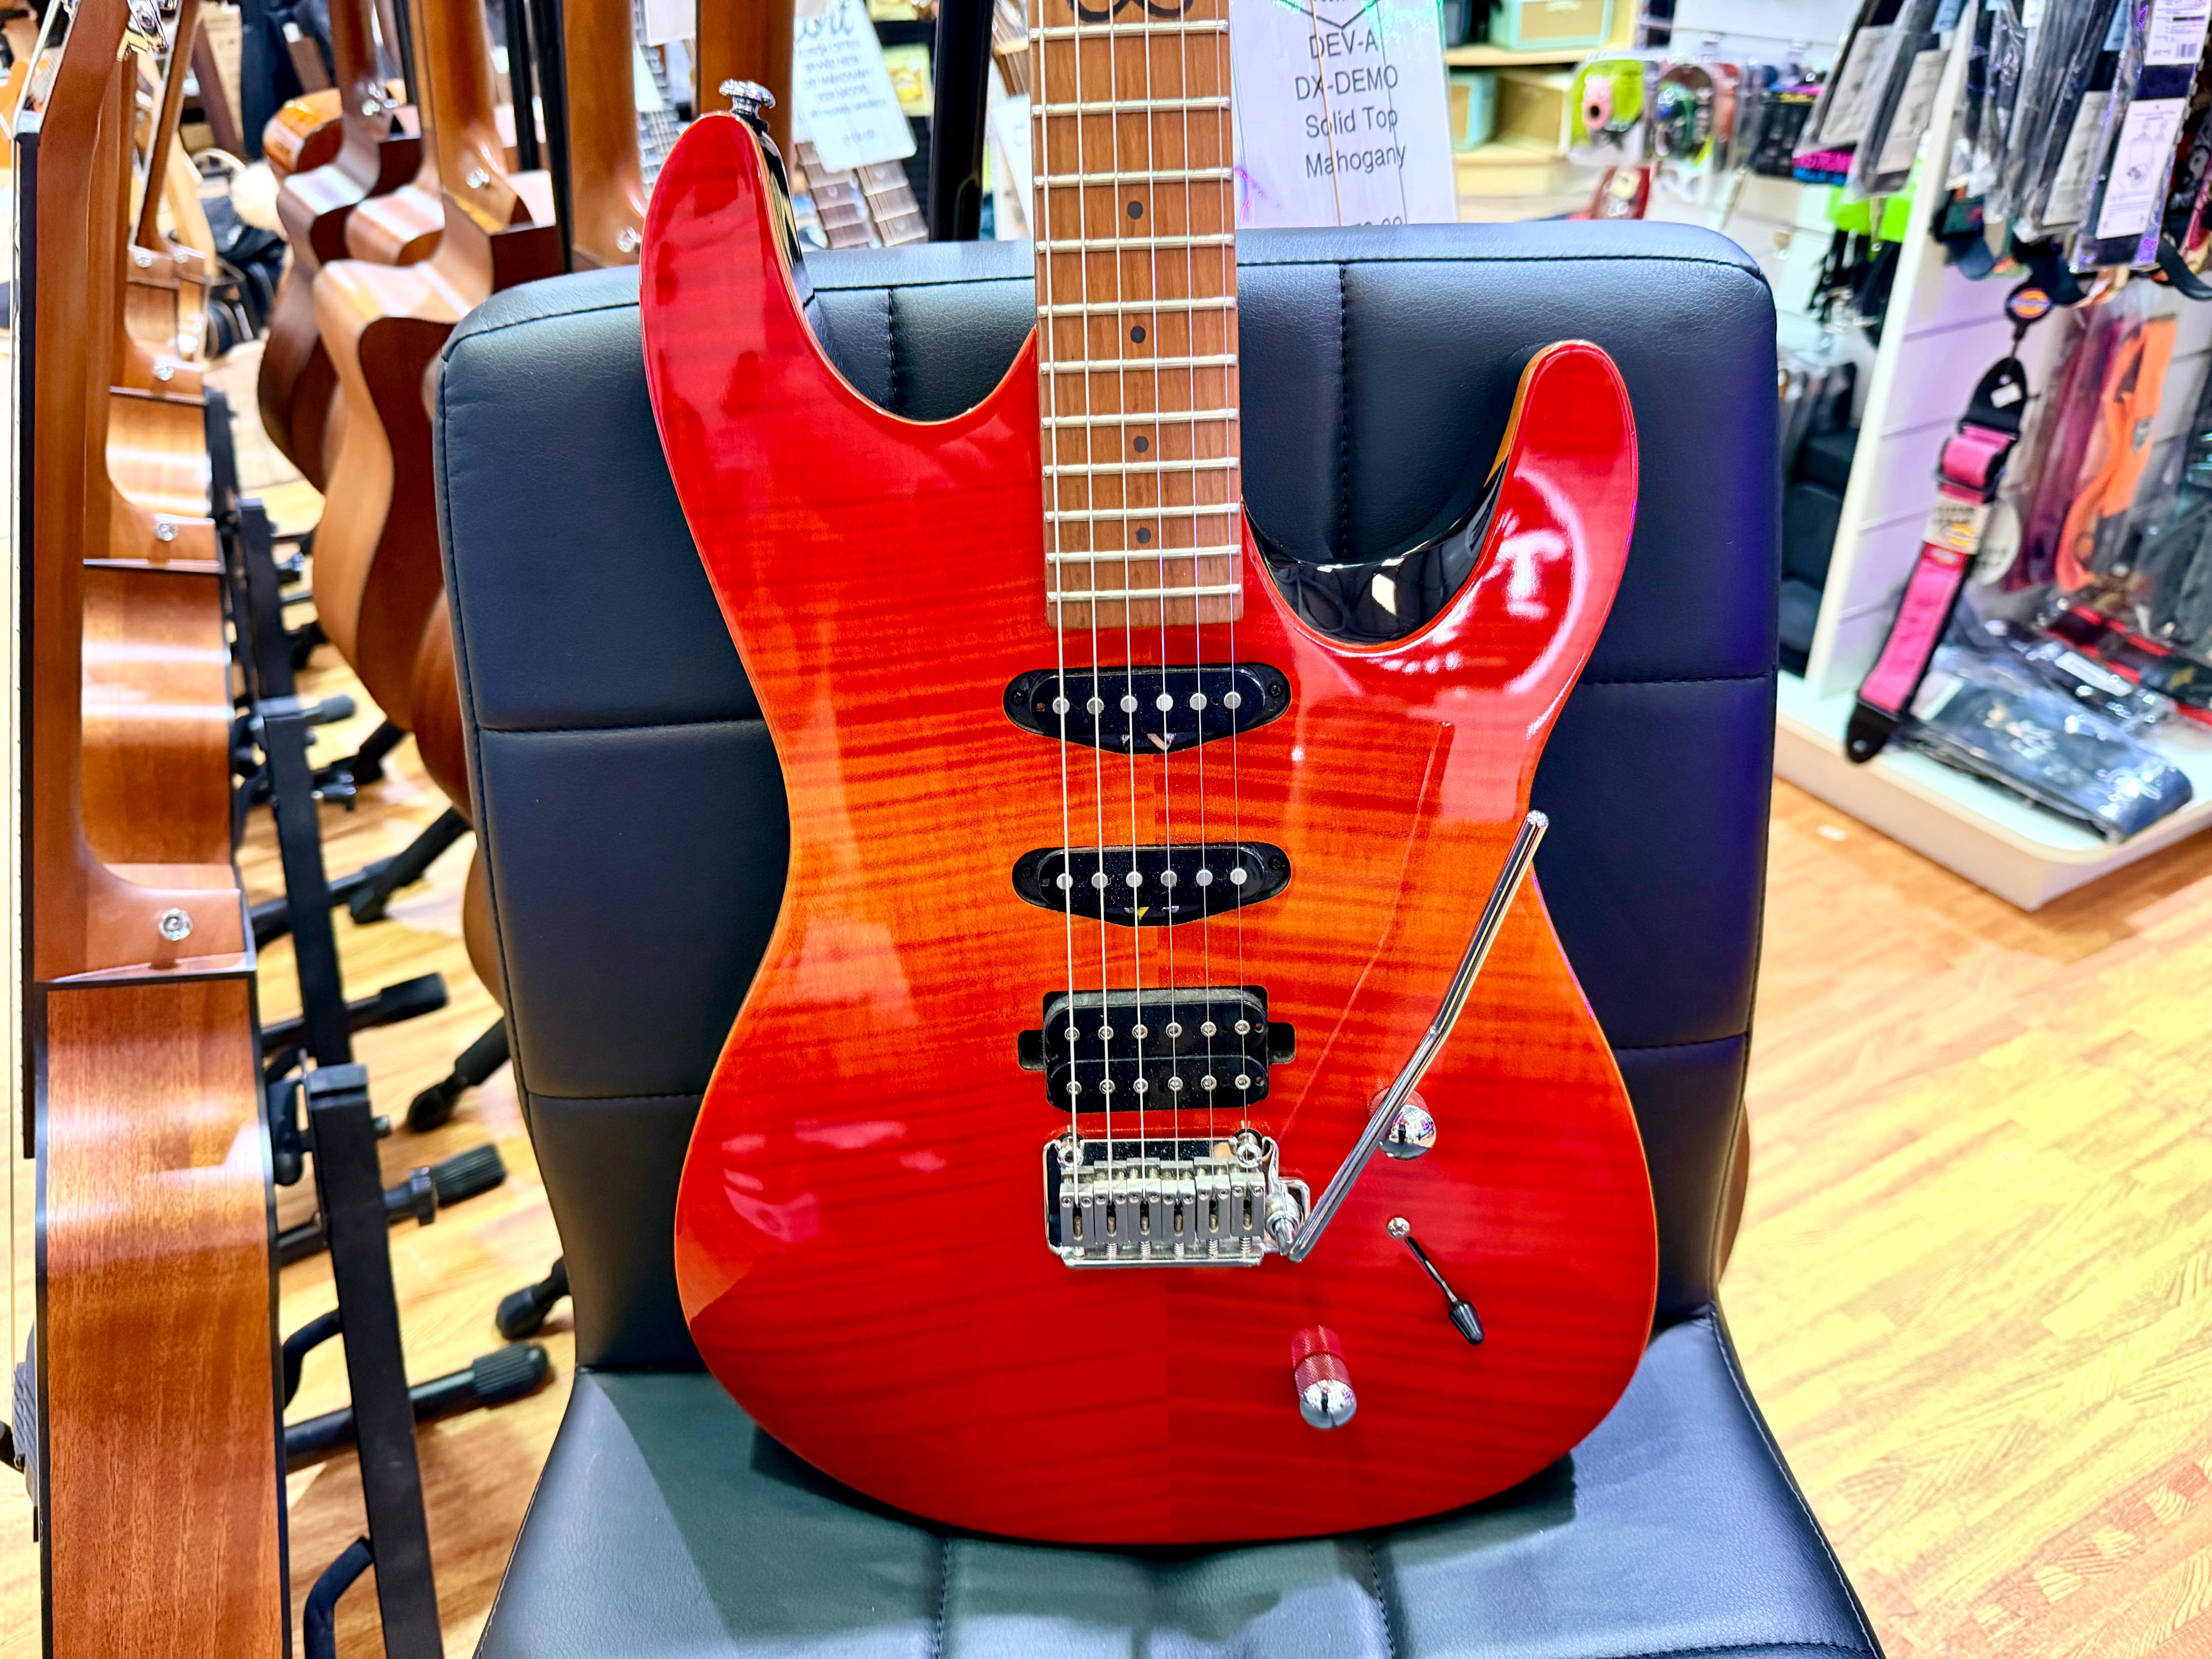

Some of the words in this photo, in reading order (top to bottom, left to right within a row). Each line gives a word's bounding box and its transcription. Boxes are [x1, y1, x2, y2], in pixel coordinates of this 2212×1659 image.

[1308, 28, 1378, 59] DEV-A
[1295, 65, 1398, 101] DX-DEMO
[1305, 110, 1356, 139] Solid
[1362, 106, 1398, 133] Top
[1305, 146, 1407, 179] Mahogany
